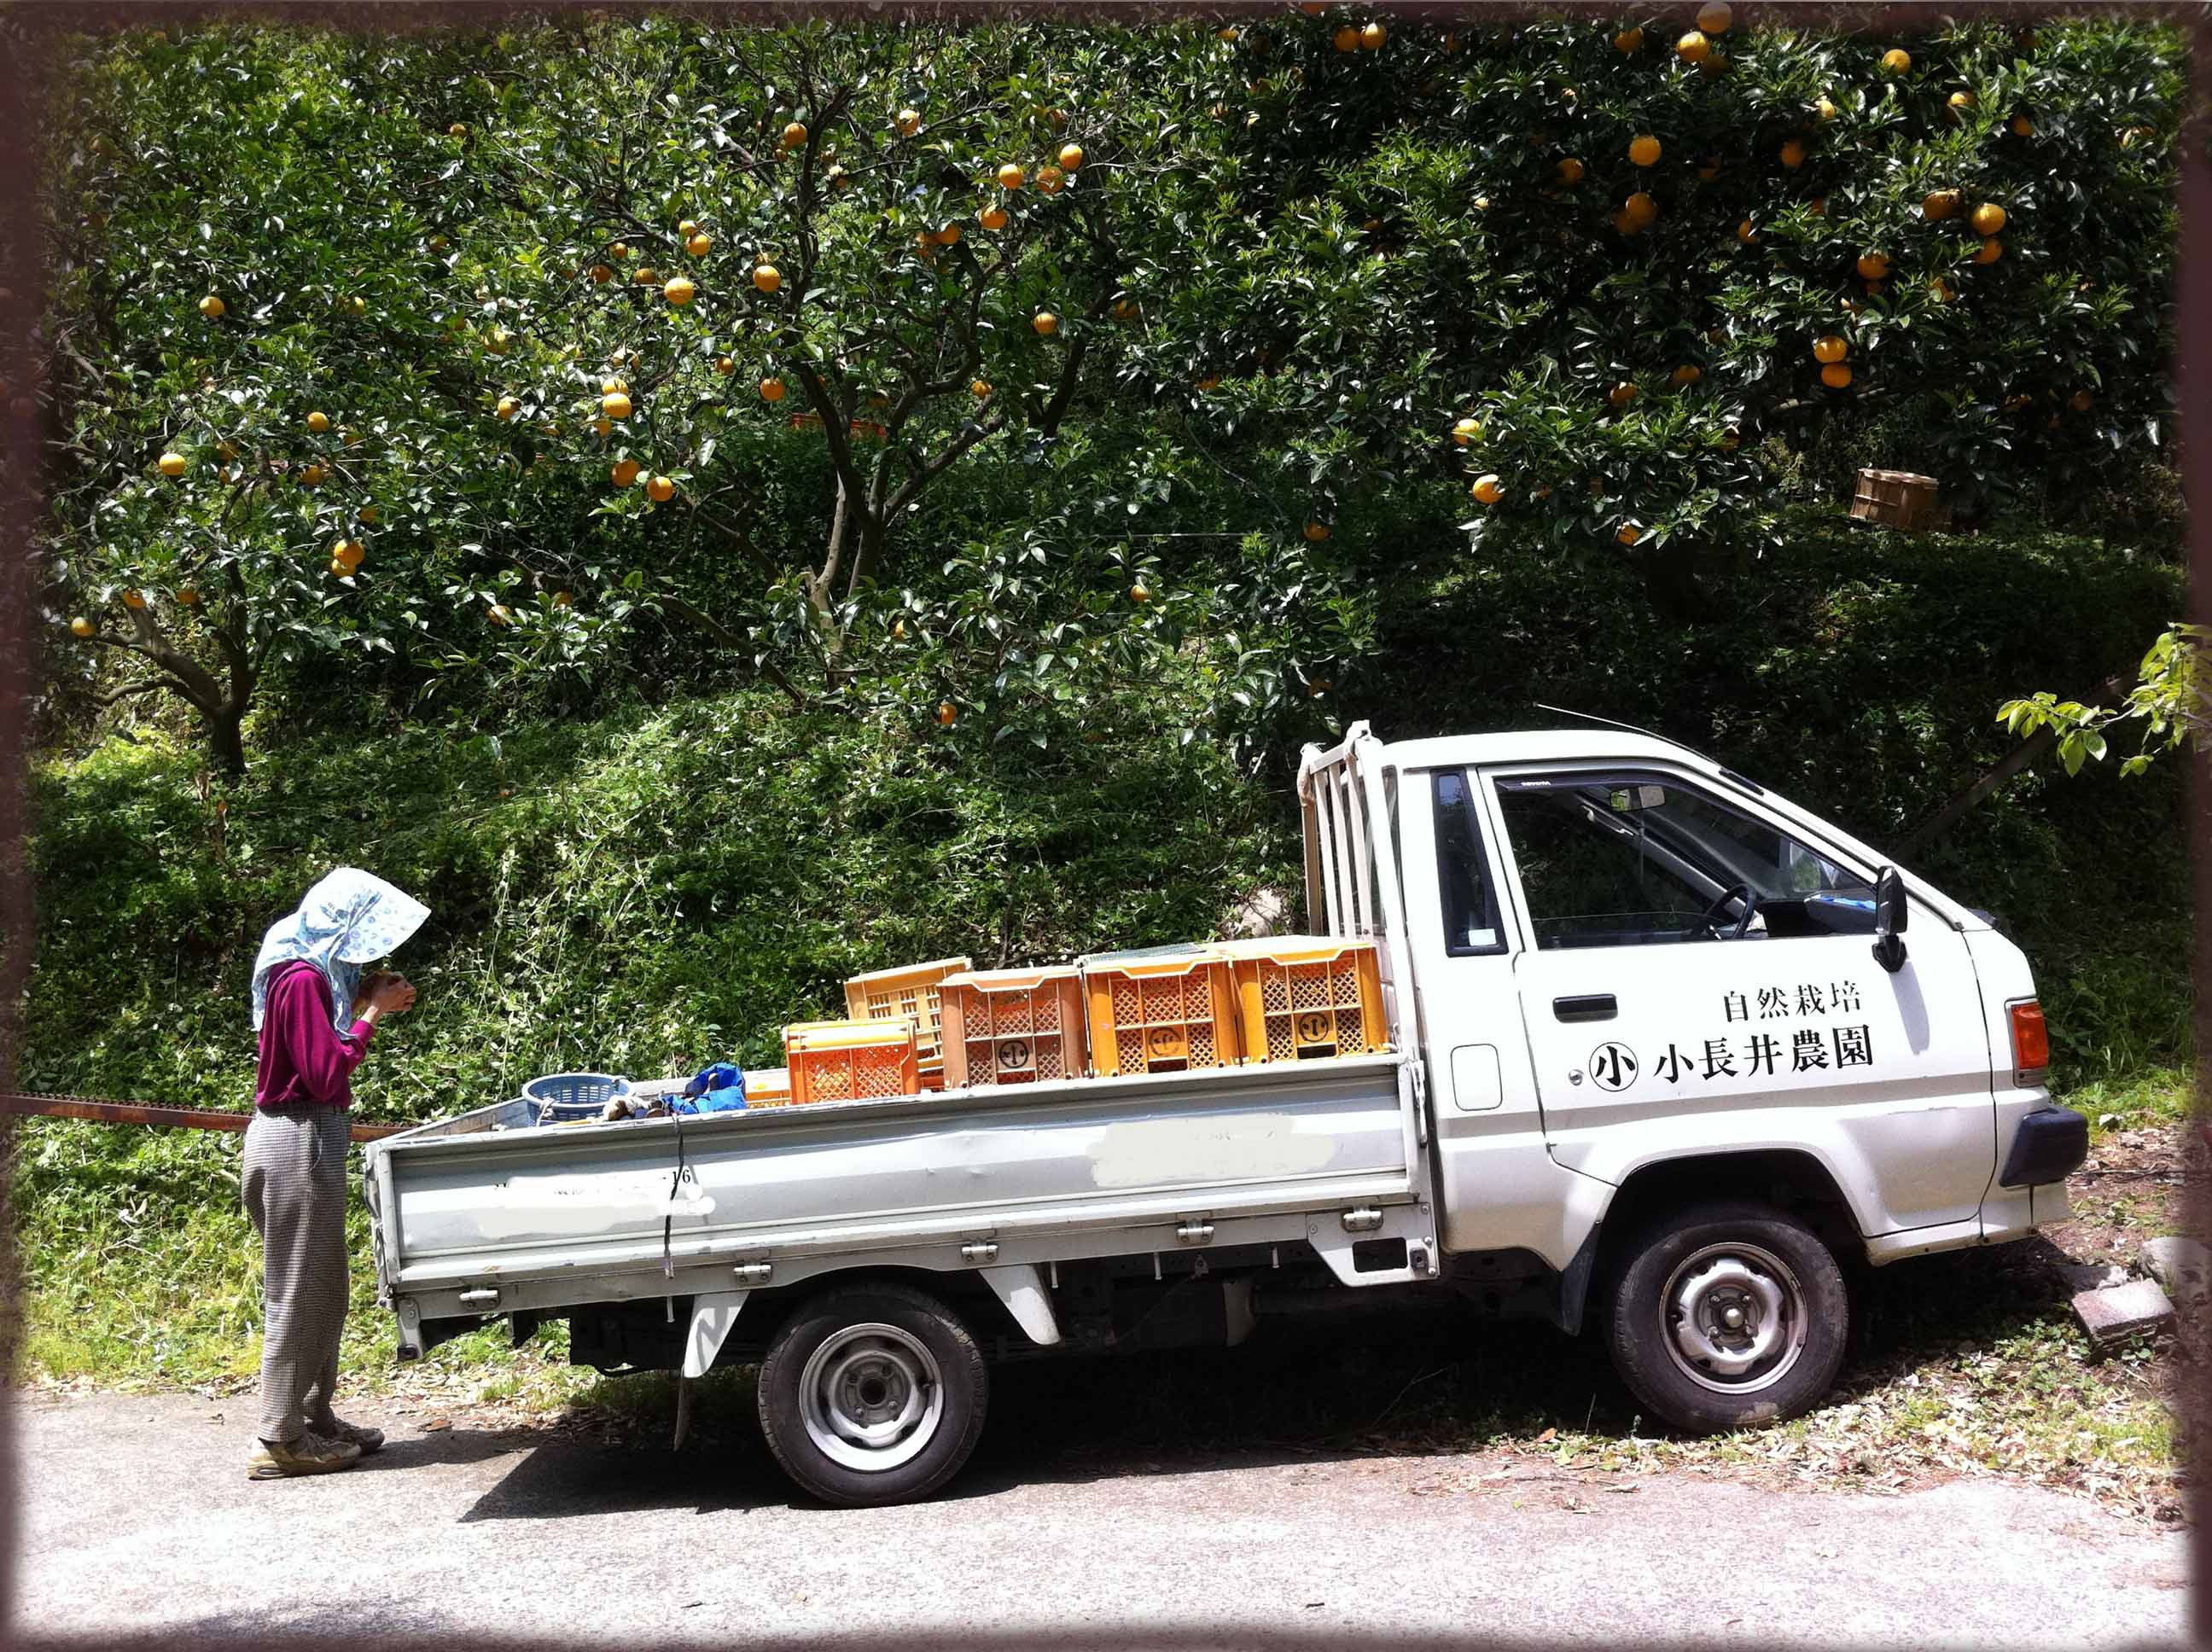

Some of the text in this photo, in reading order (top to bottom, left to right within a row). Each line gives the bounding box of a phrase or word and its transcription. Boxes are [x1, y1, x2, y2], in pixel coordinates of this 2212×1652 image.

[1723, 980, 1861, 1023] 自然栽培
[1653, 1024, 1873, 1084] 小長井農園
